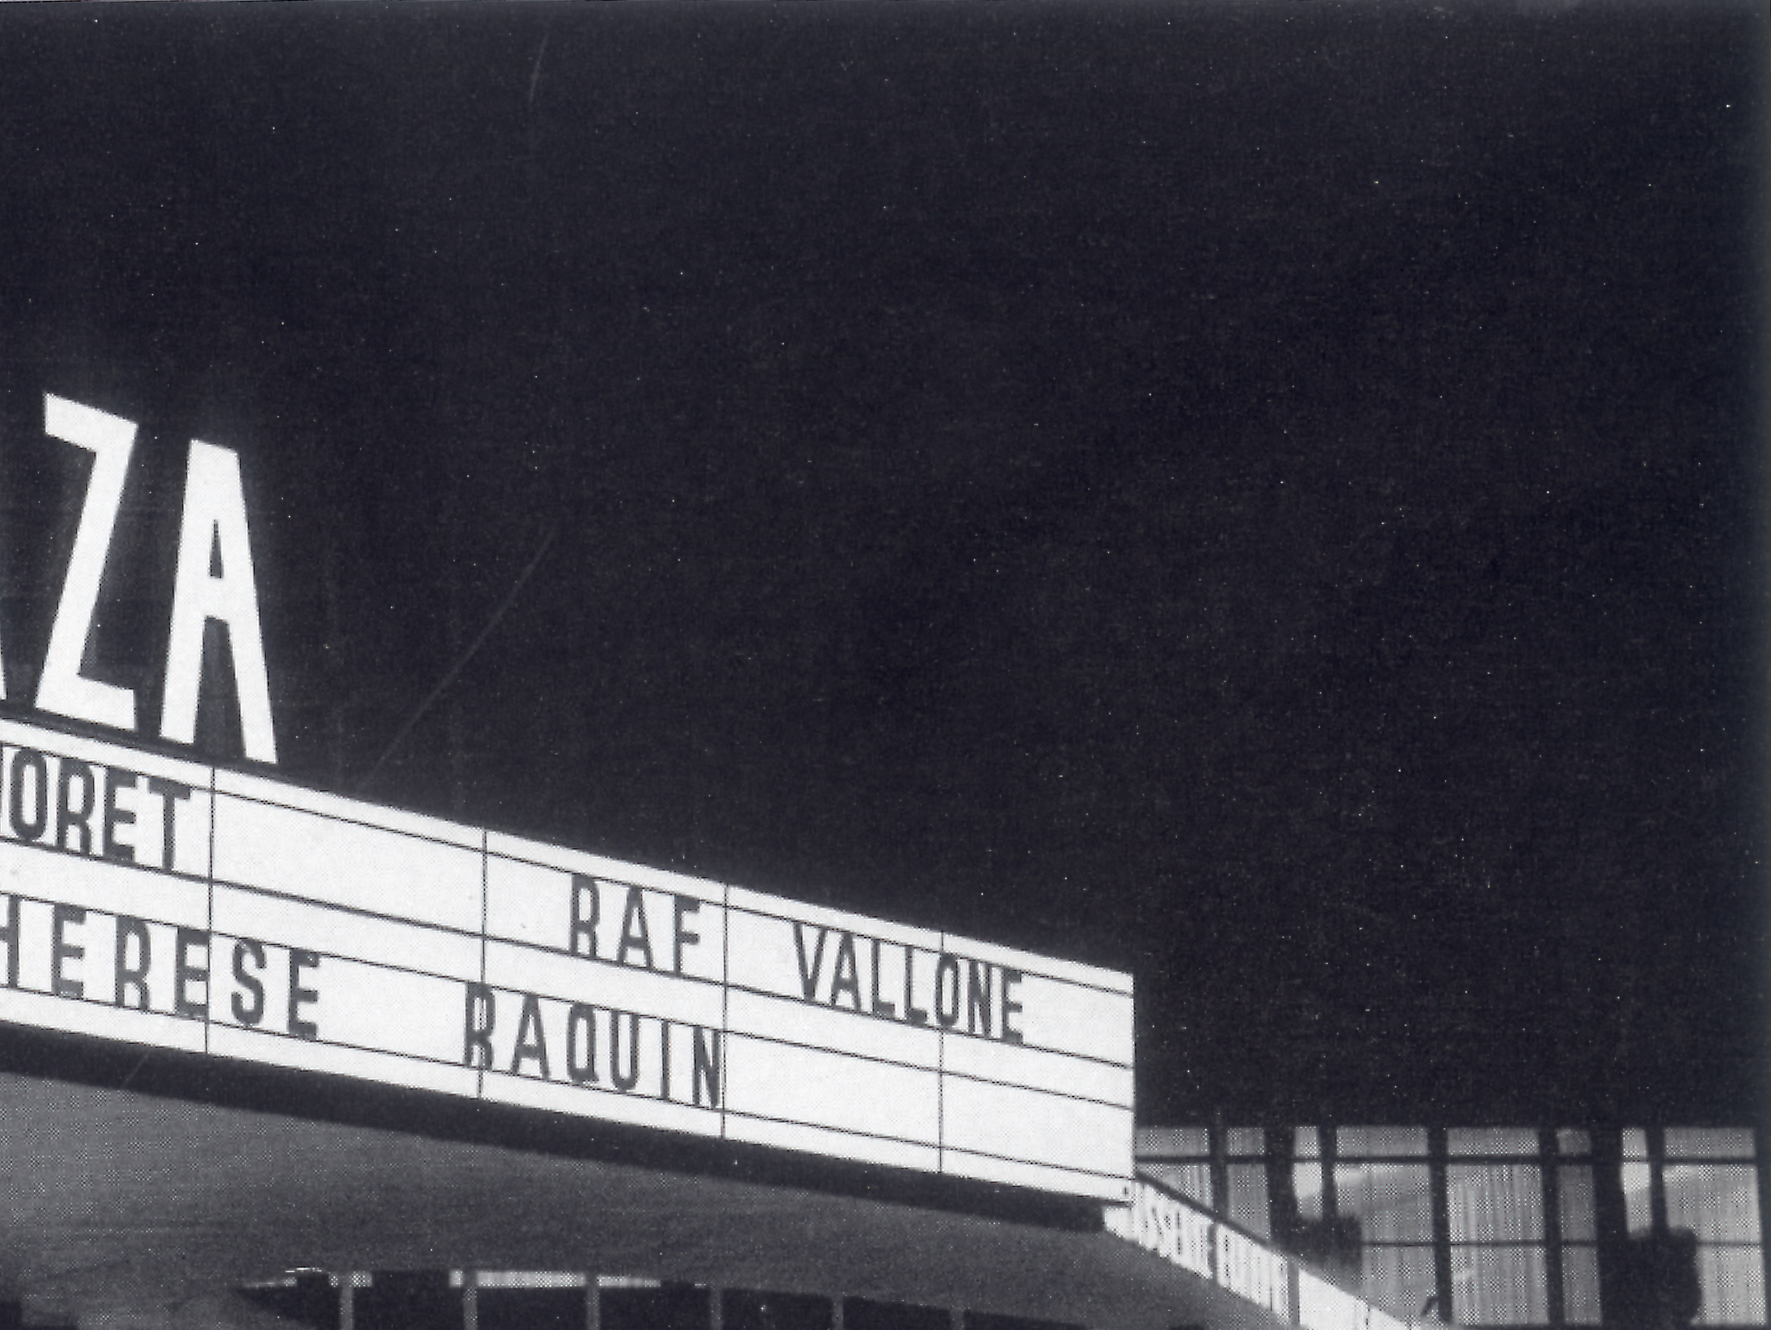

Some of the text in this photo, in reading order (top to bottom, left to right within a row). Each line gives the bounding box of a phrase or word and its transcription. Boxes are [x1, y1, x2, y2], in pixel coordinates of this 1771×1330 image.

[570, 873, 701, 977] RAF
[793, 923, 1025, 1046] VALLONE
[464, 982, 724, 1111] RAQUIN
